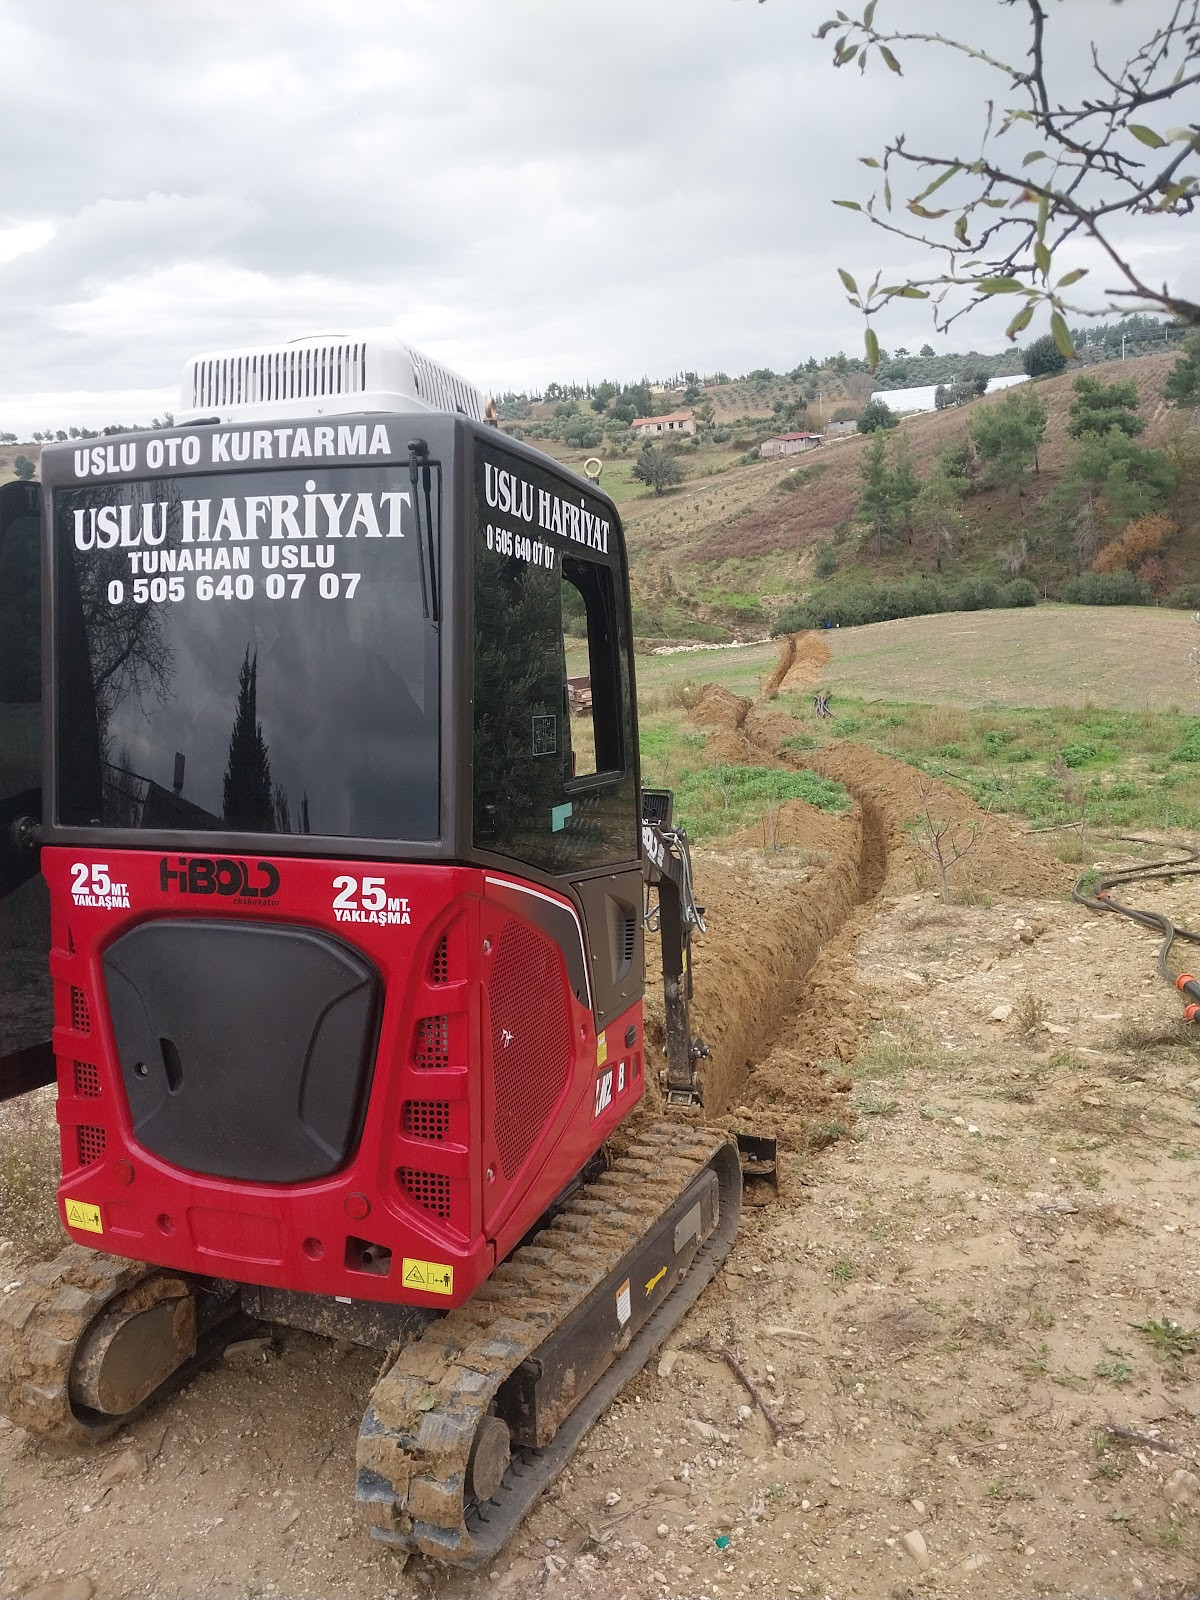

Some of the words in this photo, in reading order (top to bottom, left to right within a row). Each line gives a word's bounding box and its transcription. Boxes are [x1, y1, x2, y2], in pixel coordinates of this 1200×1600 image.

[74, 443, 136, 477] USLU
[146, 436, 200, 469] OTO
[211, 424, 391, 462] KURTARMA
[73, 502, 168, 550] USLU
[181, 480, 411, 542] HAFRİYAT
[484, 462, 534, 522] USLU
[538, 488, 610, 554] HAFRİYAT
[128, 546, 249, 574] TUNAHAN
[261, 544, 335, 569] USLU
[486, 524, 494, 550] 0
[495, 527, 513, 557] 505
[514, 534, 531, 563] 640
[532, 541, 543, 566] 07
[544, 545, 555, 570] 07
[107, 580, 124, 605] 0
[133, 577, 186, 604] 505
[195, 574, 255, 602] 640
[265, 573, 306, 600] 07
[318, 572, 361, 599] 07
[70, 863, 111, 896] 25
[332, 875, 387, 911] 25
[387, 898, 411, 912] MT.
[72, 894, 131, 911] YAKLAŞMA
[333, 909, 411, 927] YAKLAŞMA
